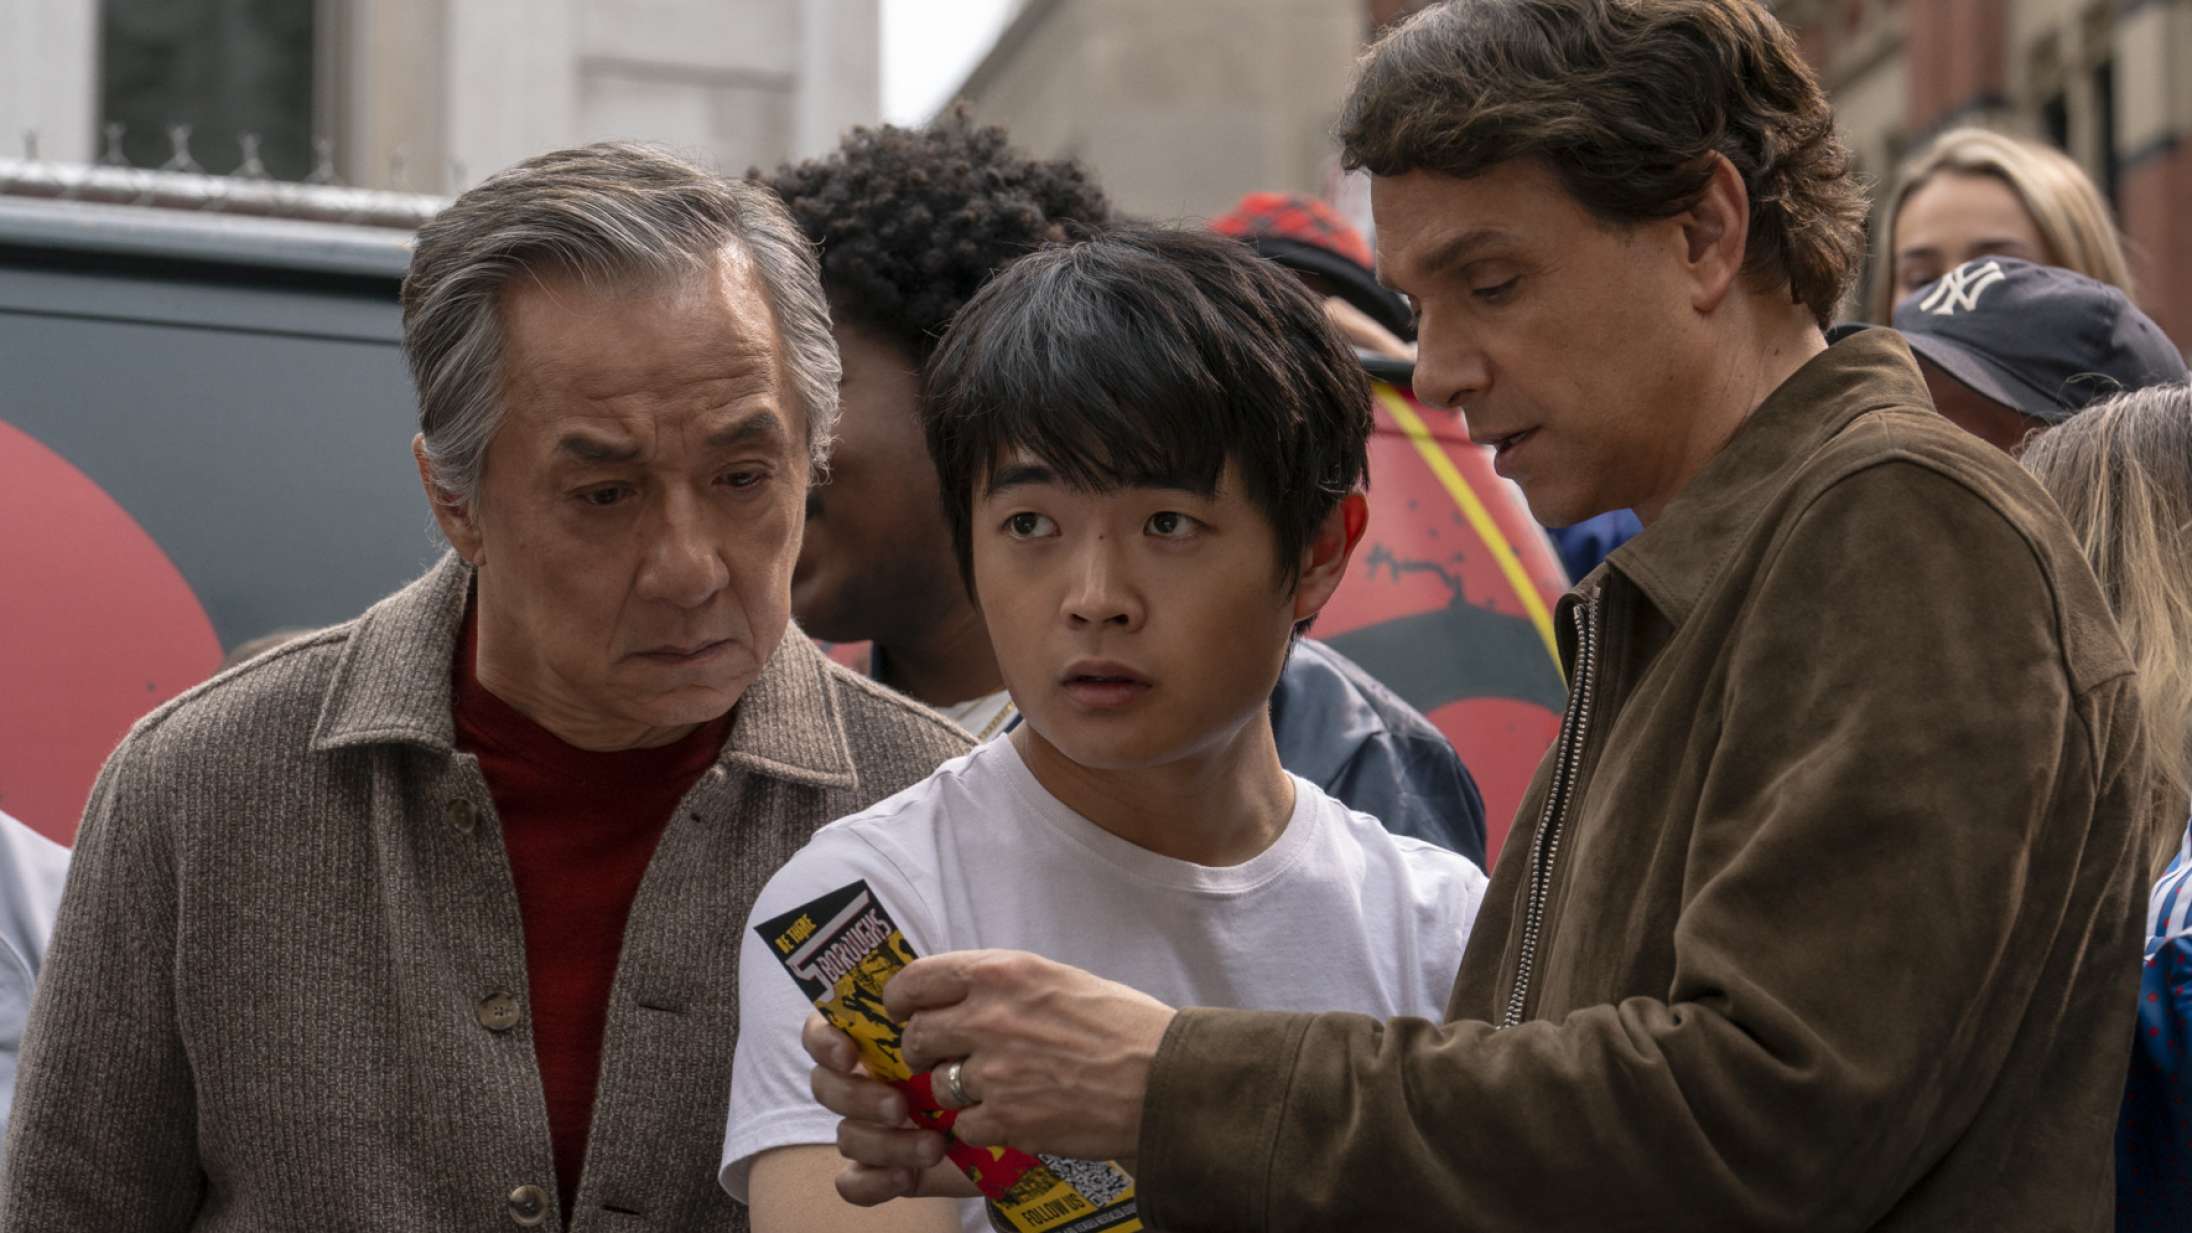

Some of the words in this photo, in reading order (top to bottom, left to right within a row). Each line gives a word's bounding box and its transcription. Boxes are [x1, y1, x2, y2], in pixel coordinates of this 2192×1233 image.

[1919, 260, 2005, 316] NY
[816, 908, 891, 982] BOROUGHS
[1020, 1198, 1070, 1227] FOLLOW
[1062, 1193, 1086, 1211] US
